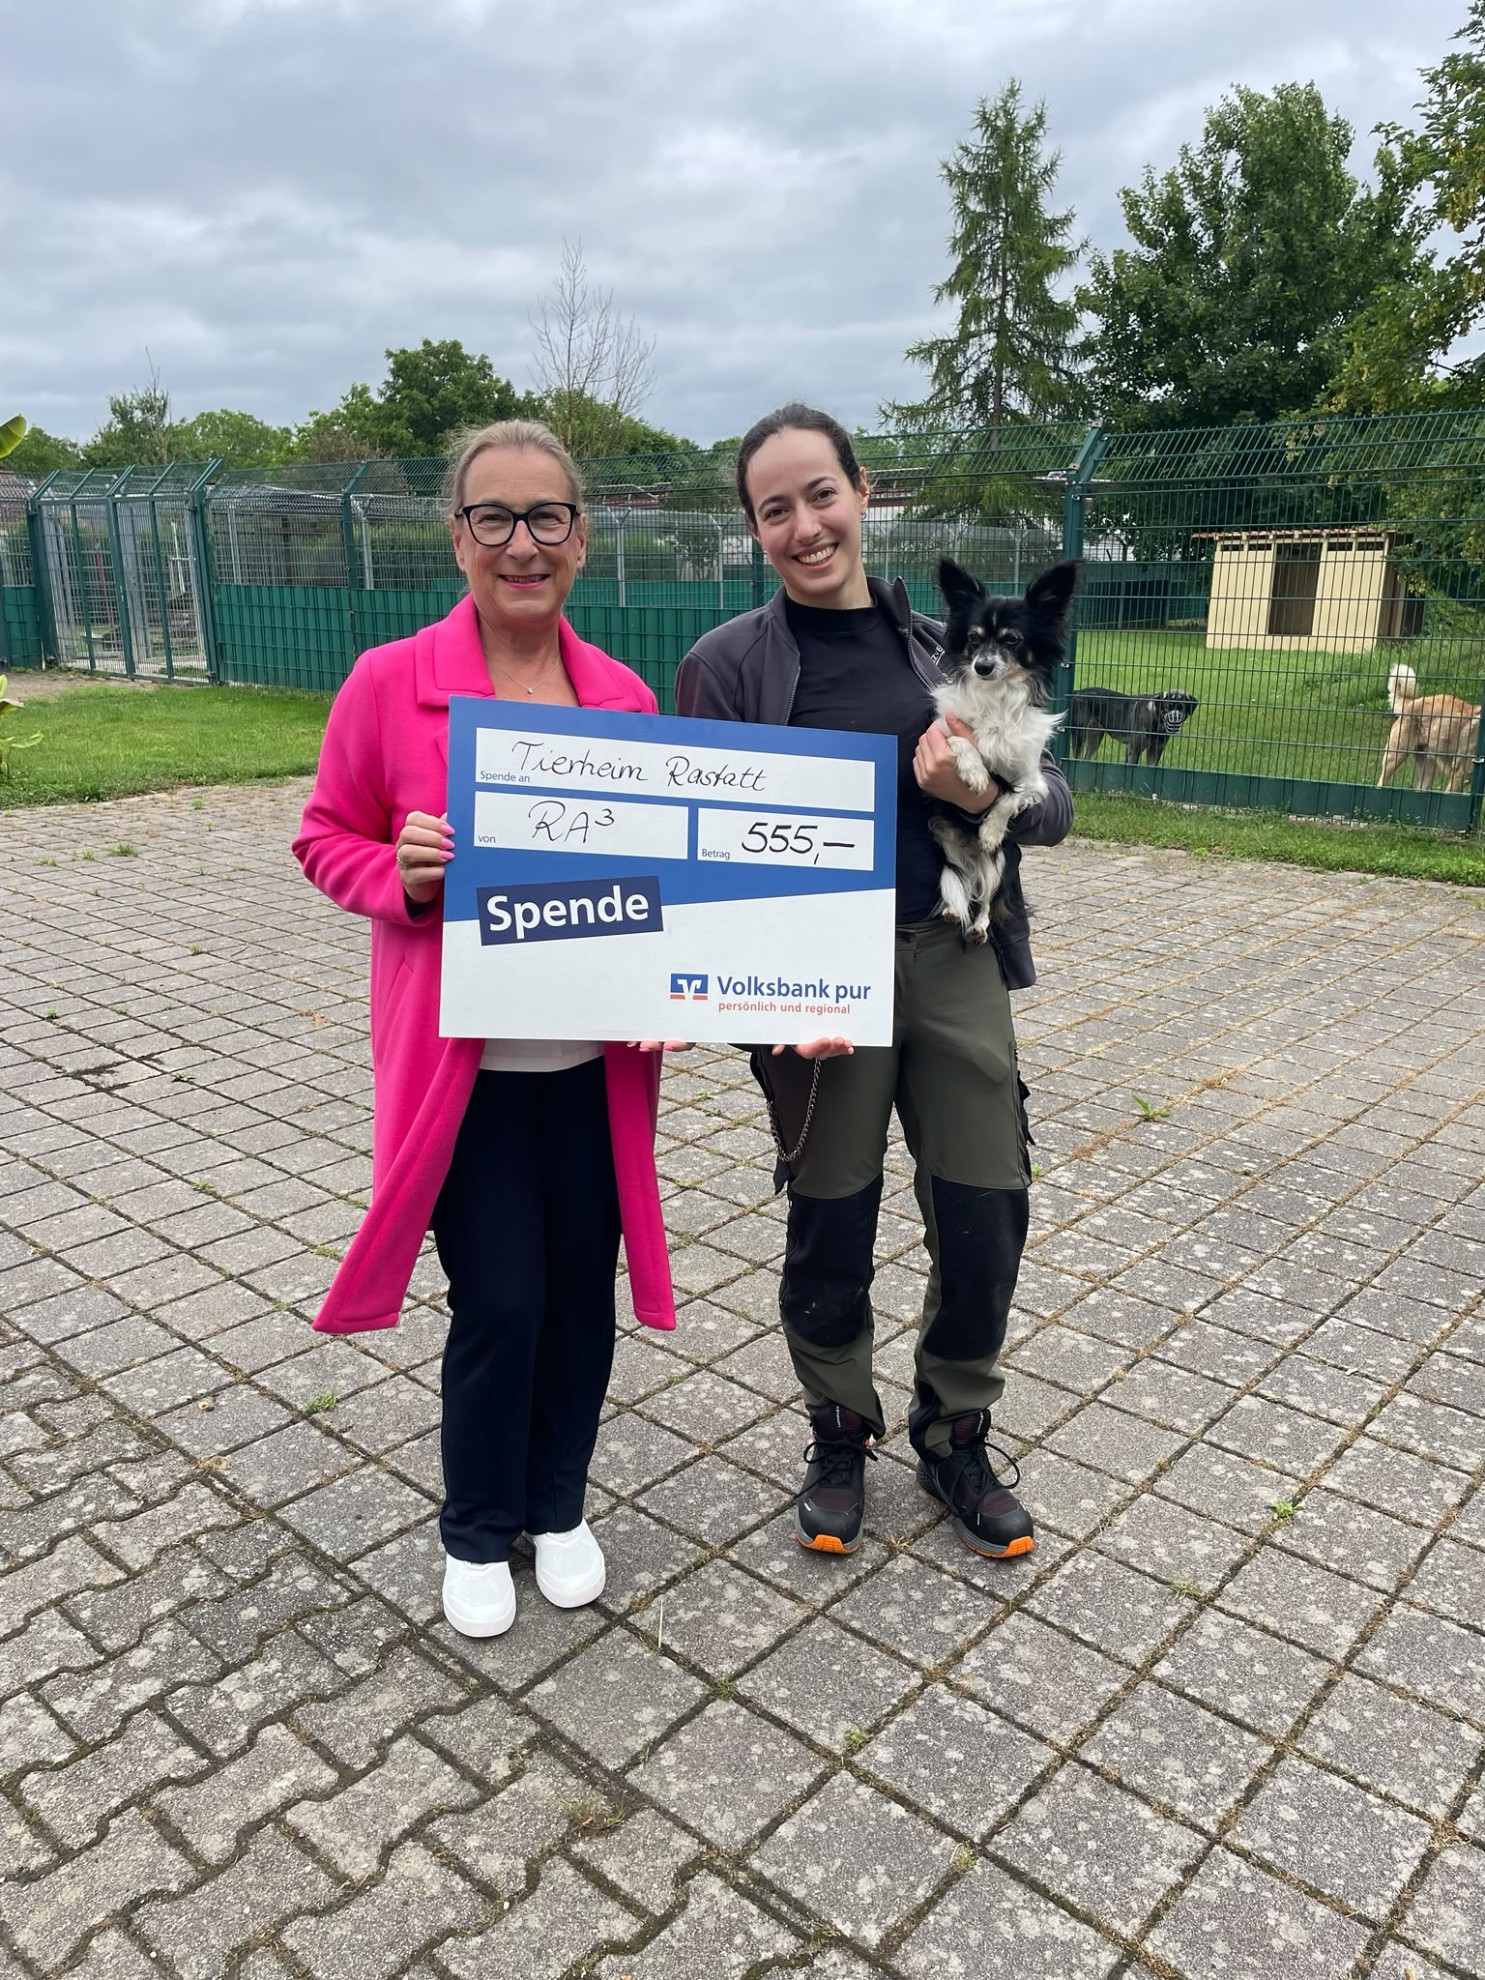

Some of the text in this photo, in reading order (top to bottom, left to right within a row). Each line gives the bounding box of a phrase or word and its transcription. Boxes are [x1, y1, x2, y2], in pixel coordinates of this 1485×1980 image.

[512, 741, 766, 791] Tierheim Rastatt
[480, 771, 531, 783] Spende an
[478, 835, 496, 844] von
[701, 848, 731, 860] Betrag
[487, 885, 649, 939] Spende
[717, 976, 872, 1004] Volksbank pur
[718, 1001, 851, 1016] persönlich und regional
